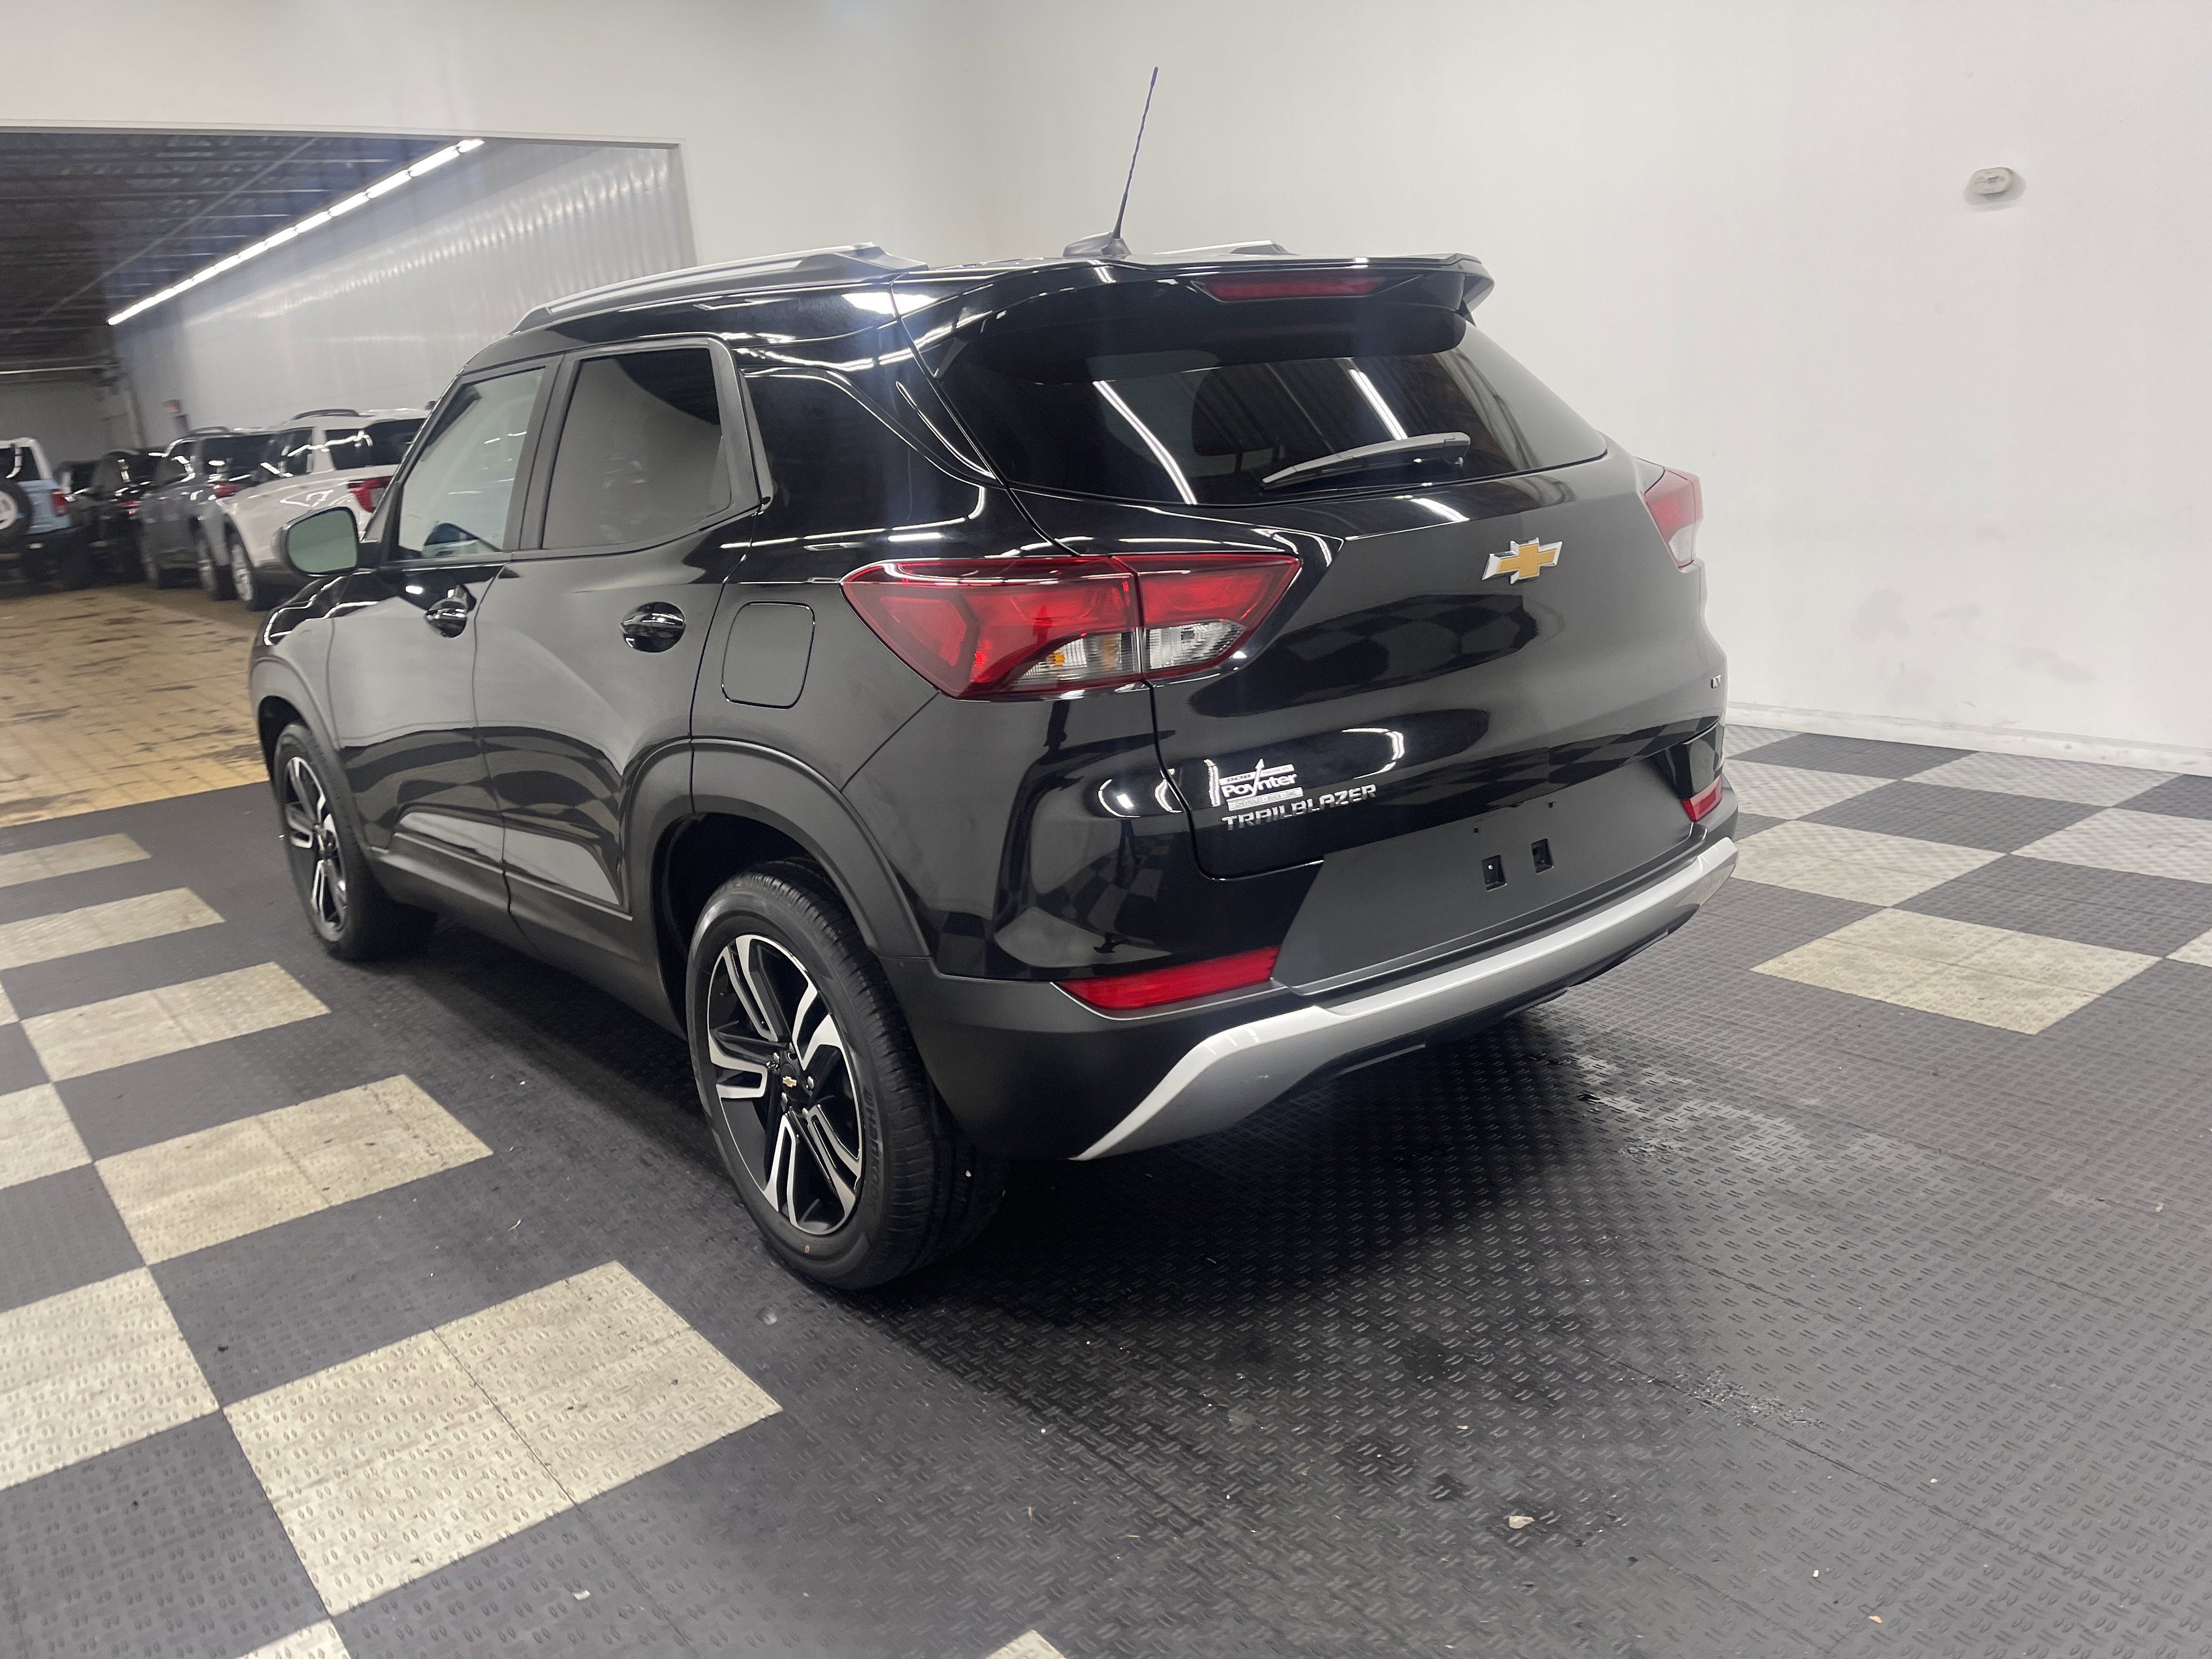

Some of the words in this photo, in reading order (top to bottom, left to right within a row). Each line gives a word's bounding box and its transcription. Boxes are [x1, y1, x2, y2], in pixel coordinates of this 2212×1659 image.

[1221, 773, 1297, 797] Poynter
[1226, 774, 1251, 782] BOB
[1221, 783, 1376, 831] TRAILBLAZER
[1235, 794, 1262, 808] CHEVROLET
[1267, 792, 1281, 800] BUICK
